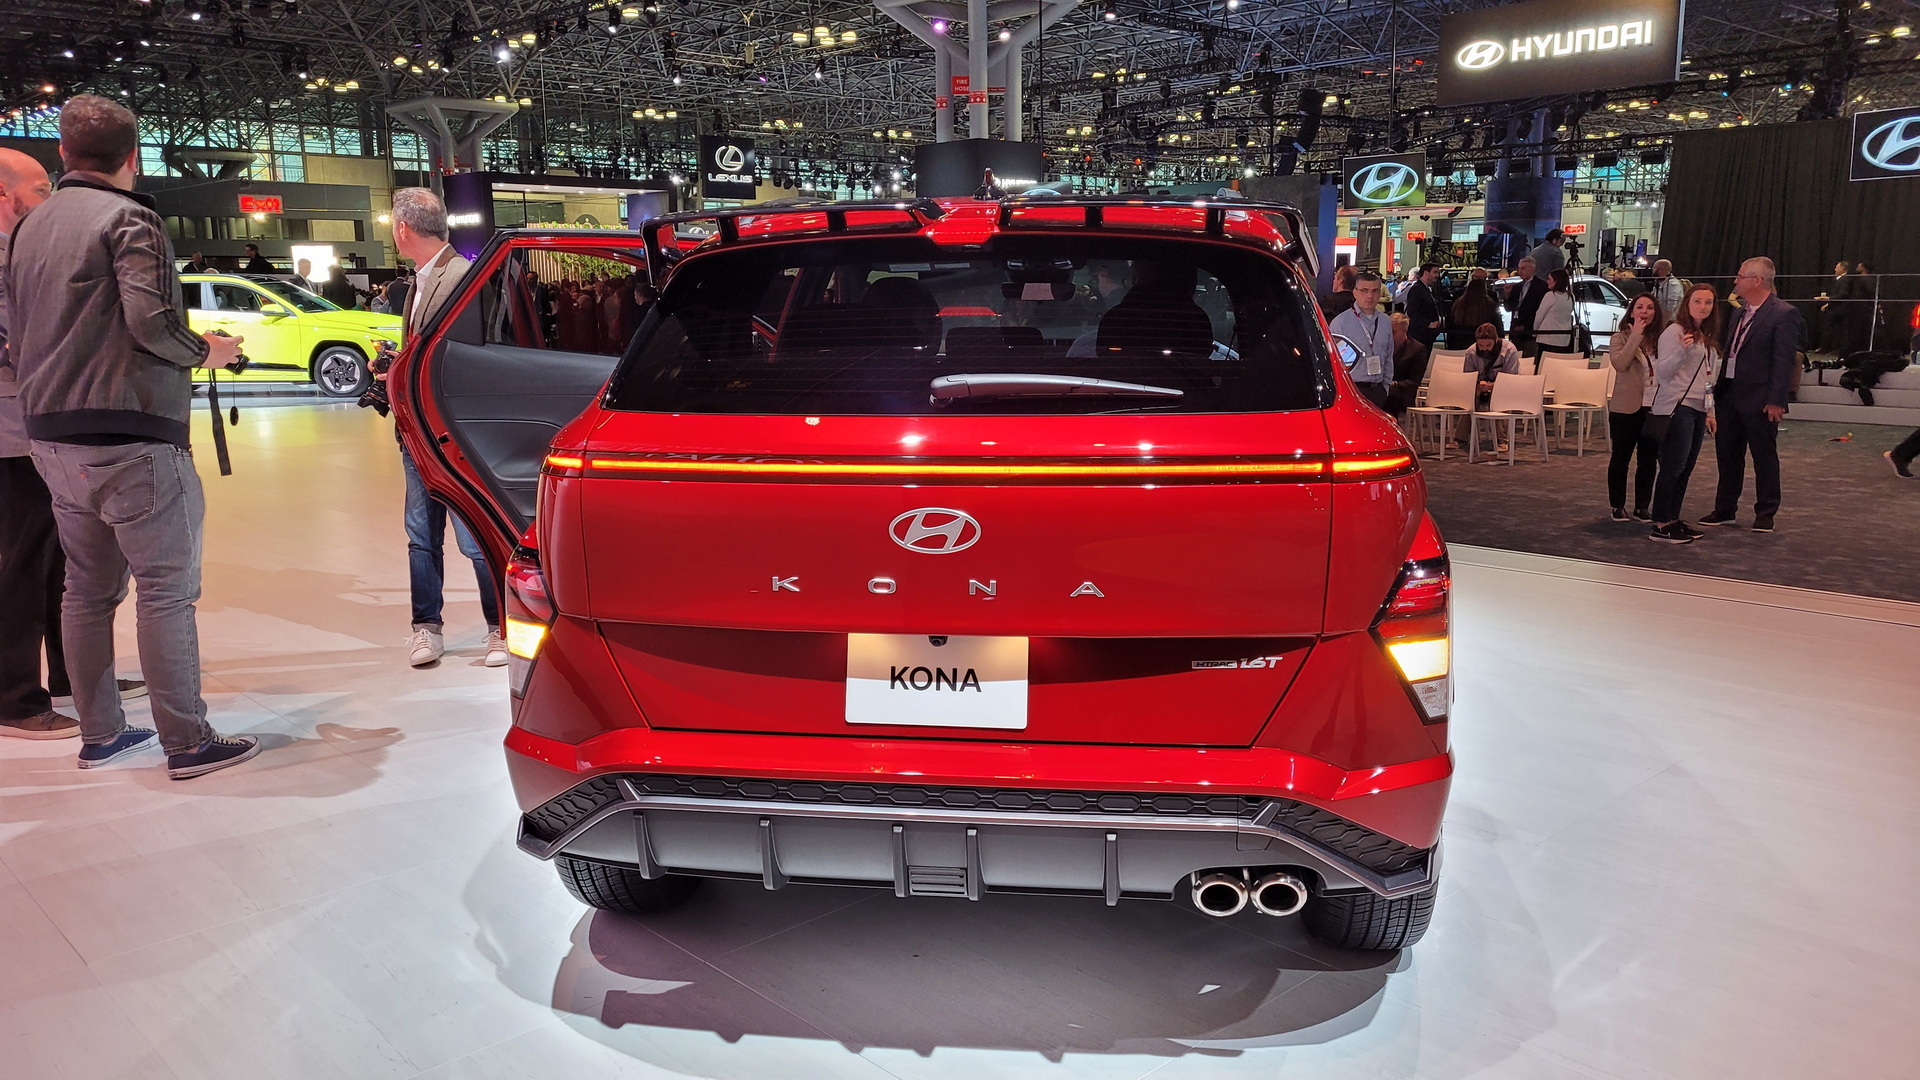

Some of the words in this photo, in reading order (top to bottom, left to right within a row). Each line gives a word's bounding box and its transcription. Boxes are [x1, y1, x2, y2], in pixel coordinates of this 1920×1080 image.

[1511, 20, 1652, 62] HYUNDAI
[707, 173, 753, 183] LEXUS
[772, 576, 1105, 598] KONA
[889, 665, 983, 692] KONA
